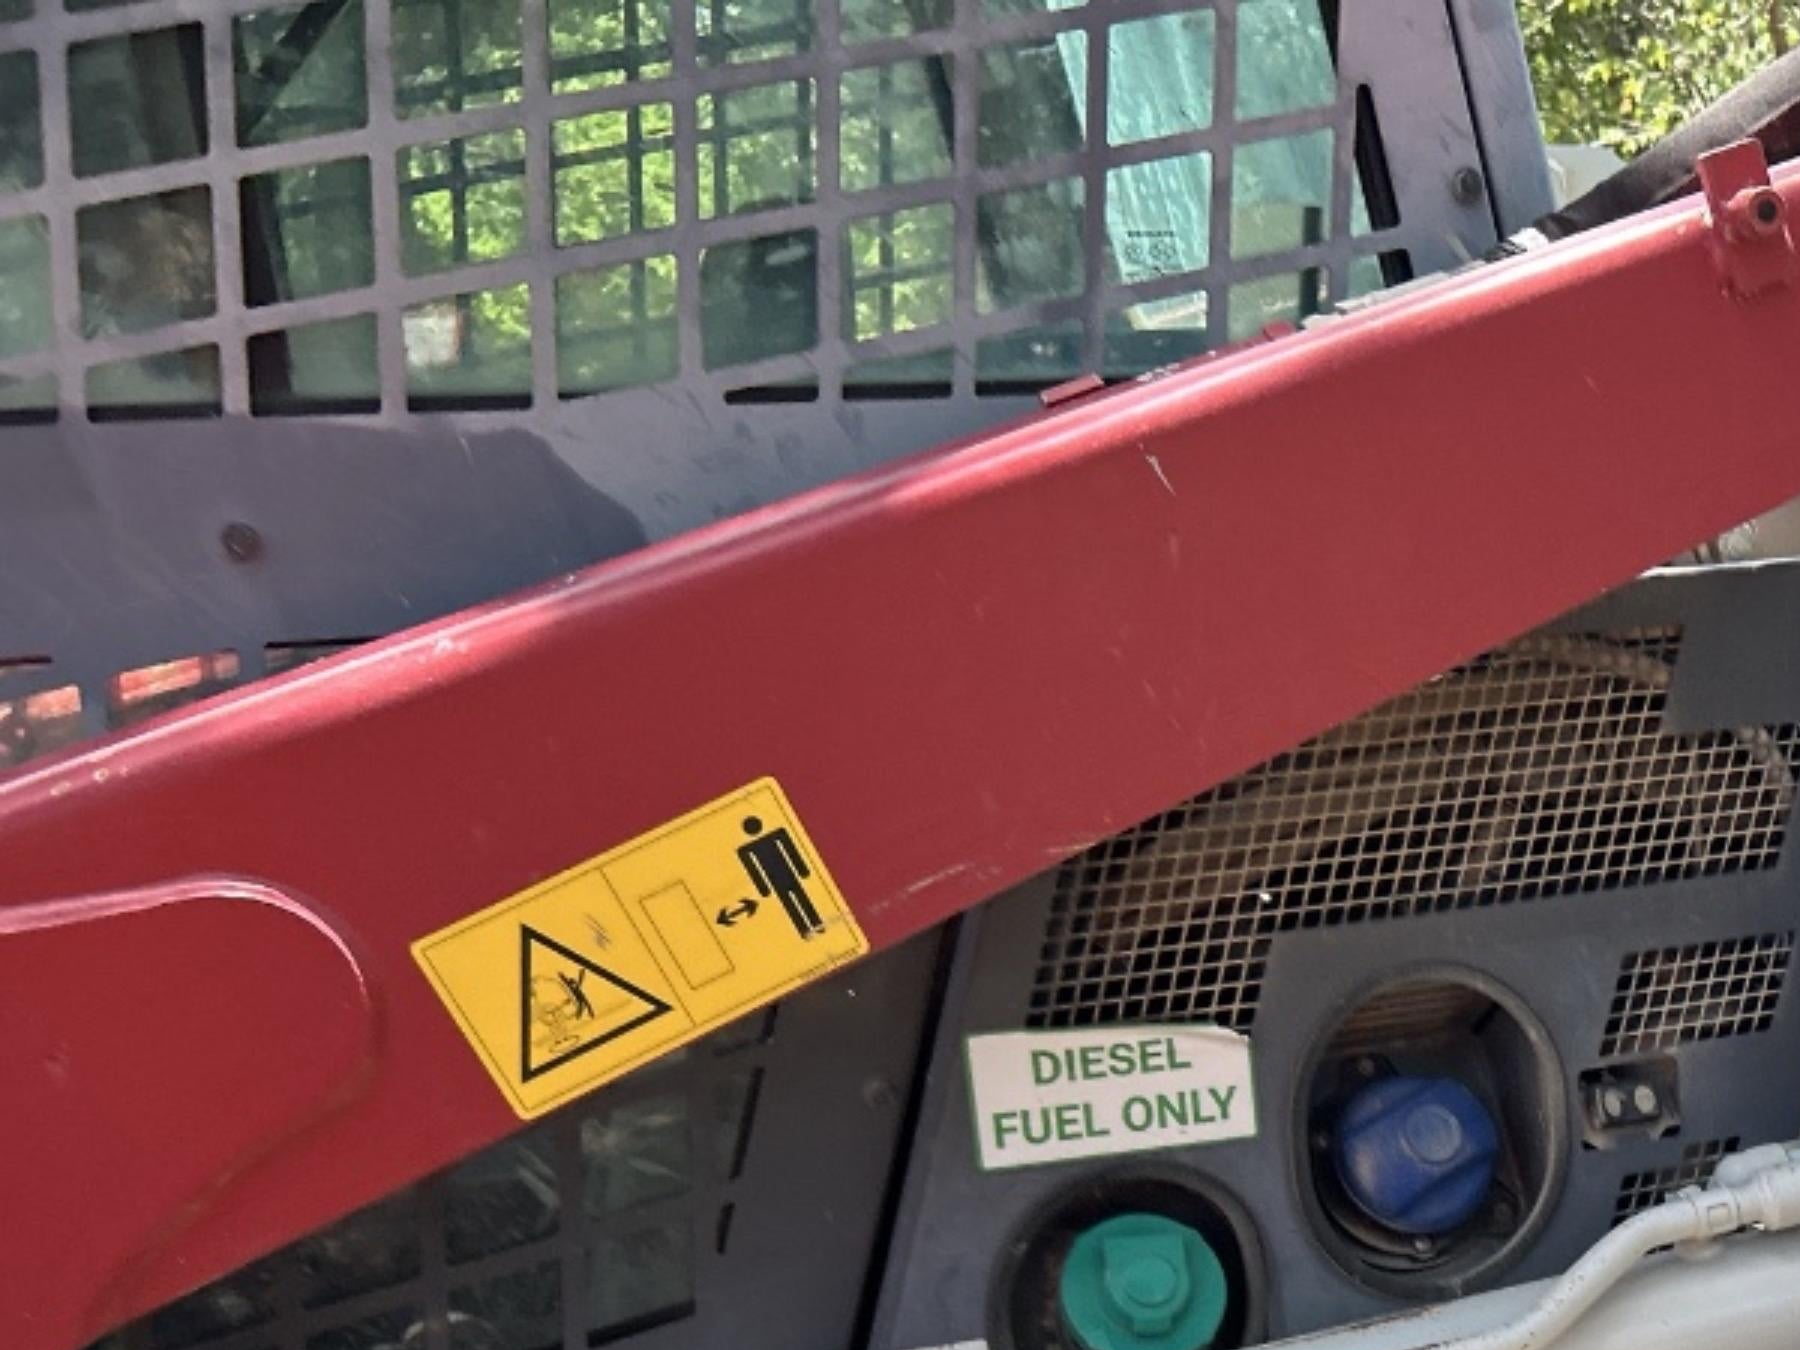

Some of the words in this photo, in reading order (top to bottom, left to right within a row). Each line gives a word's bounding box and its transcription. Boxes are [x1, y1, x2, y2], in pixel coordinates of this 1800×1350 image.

[1030, 1036, 1192, 1085] DIESEL
[992, 1102, 1110, 1149] FUEL
[1121, 1085, 1237, 1133] ONLY
